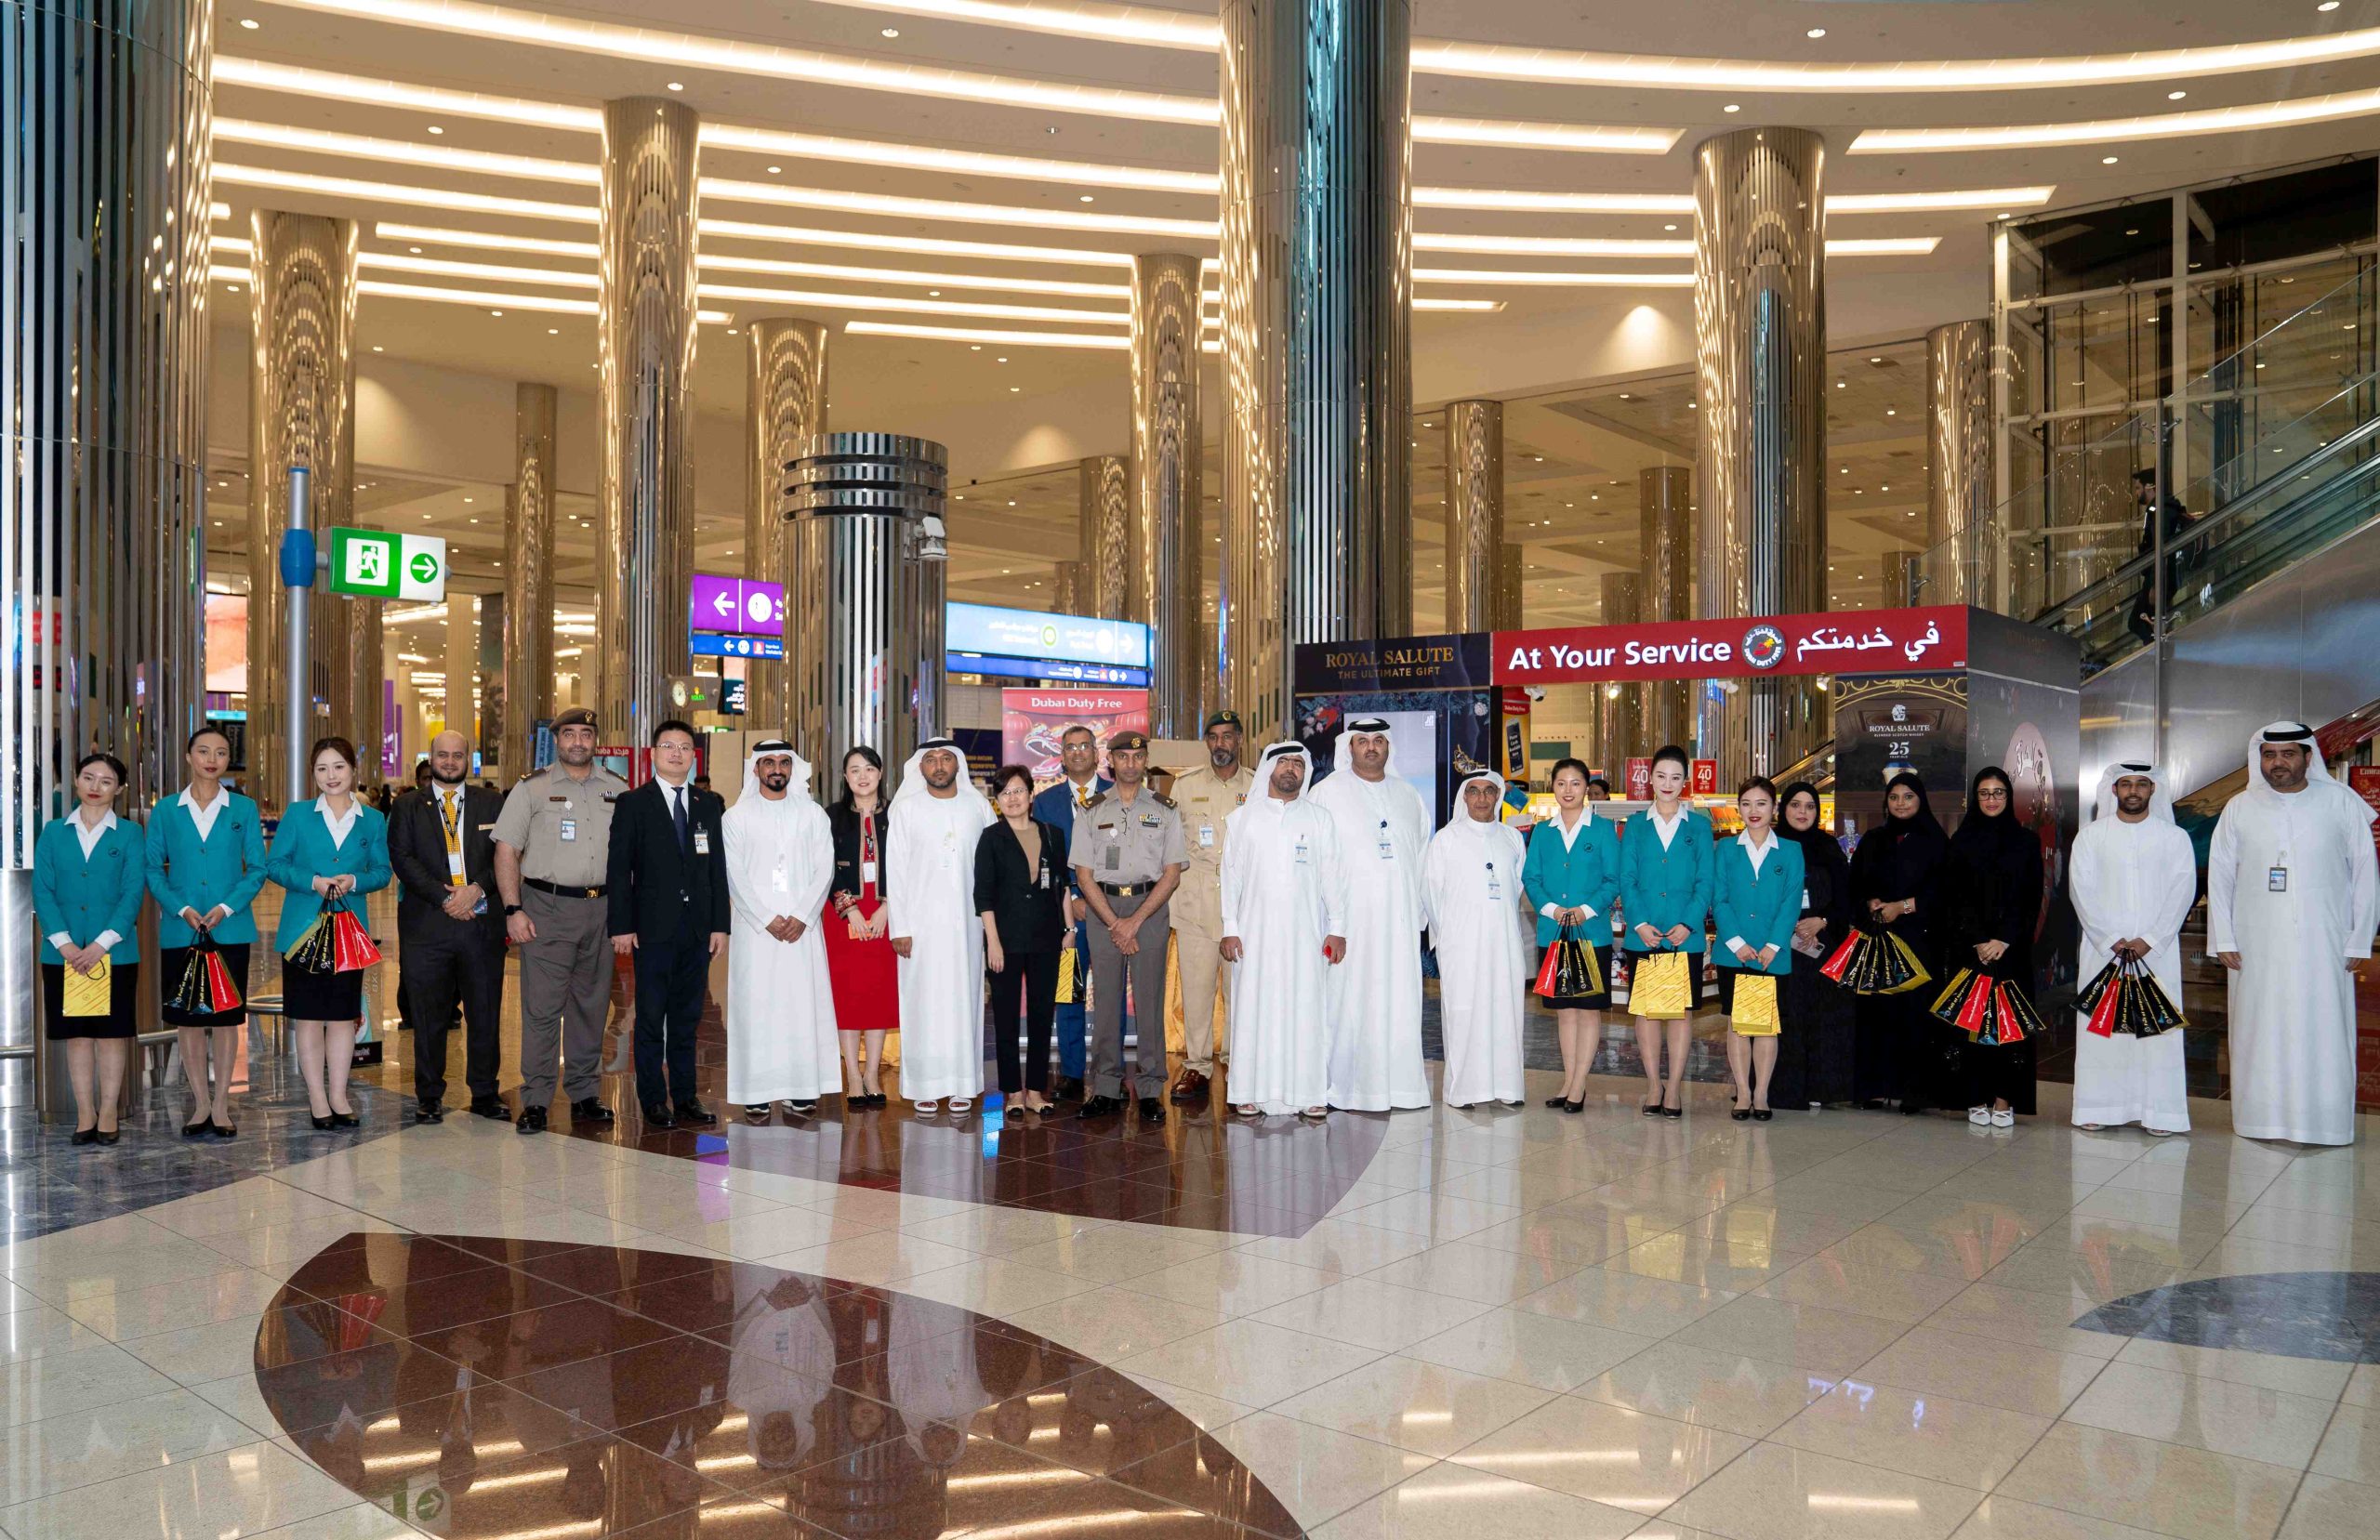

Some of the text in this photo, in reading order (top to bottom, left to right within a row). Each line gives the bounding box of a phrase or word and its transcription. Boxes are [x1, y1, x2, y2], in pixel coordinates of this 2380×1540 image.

[1796, 620, 1940, 662] في خدمتكم
[1326, 647, 1454, 668] ROYAL SALUTE
[1509, 638, 1731, 670] At Your Service
[1744, 646, 1782, 666] DUBAI DUTY FREE
[1338, 667, 1440, 679] THE ULTIMATE GIFT
[1031, 698, 1123, 709] Dubai Duty Free
[1889, 742, 1909, 755] 25
[1632, 770, 1648, 783] 40
[1698, 769, 1712, 780] 40
